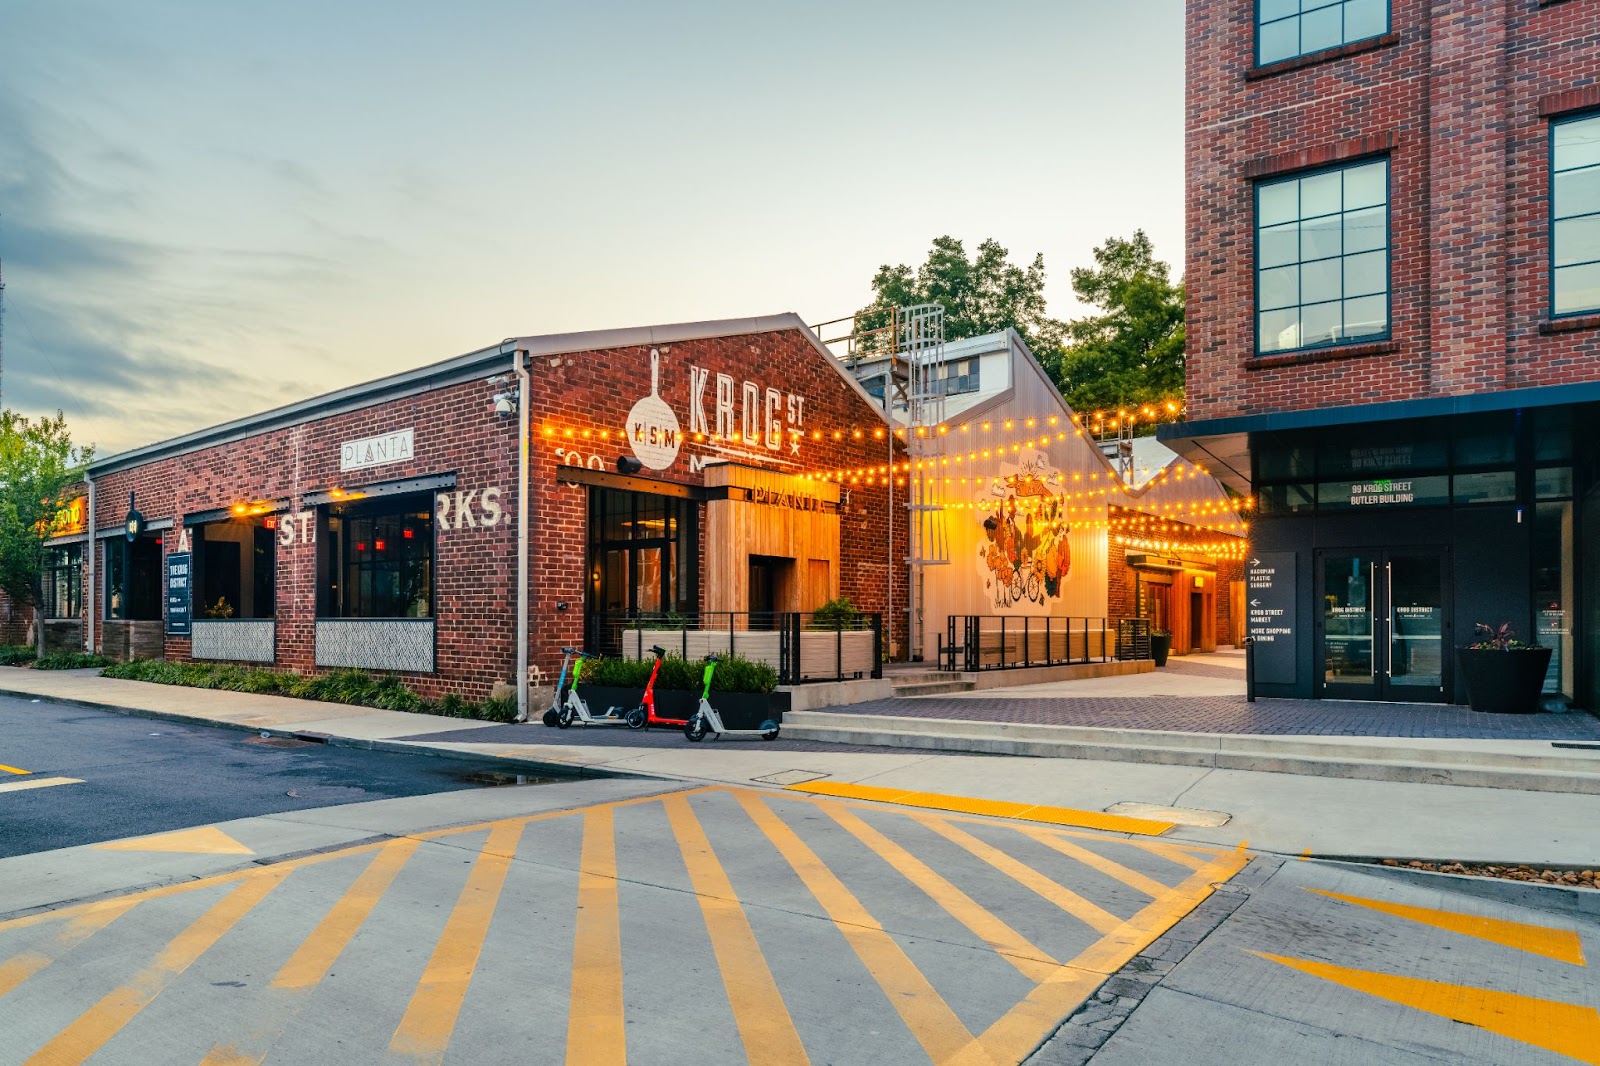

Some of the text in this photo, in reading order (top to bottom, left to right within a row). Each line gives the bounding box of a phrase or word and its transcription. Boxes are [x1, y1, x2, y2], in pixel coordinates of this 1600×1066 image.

[690, 366, 805, 450] KROG ST
[343, 436, 409, 466] PLANTA
[752, 484, 827, 514] PLANTA
[1350, 493, 1414, 505] BUTLER BUILDING
[1351, 482, 1412, 493] 99 KROG STREET
[280, 511, 316, 546] ST
[170, 577, 188, 588] DISTRICT
